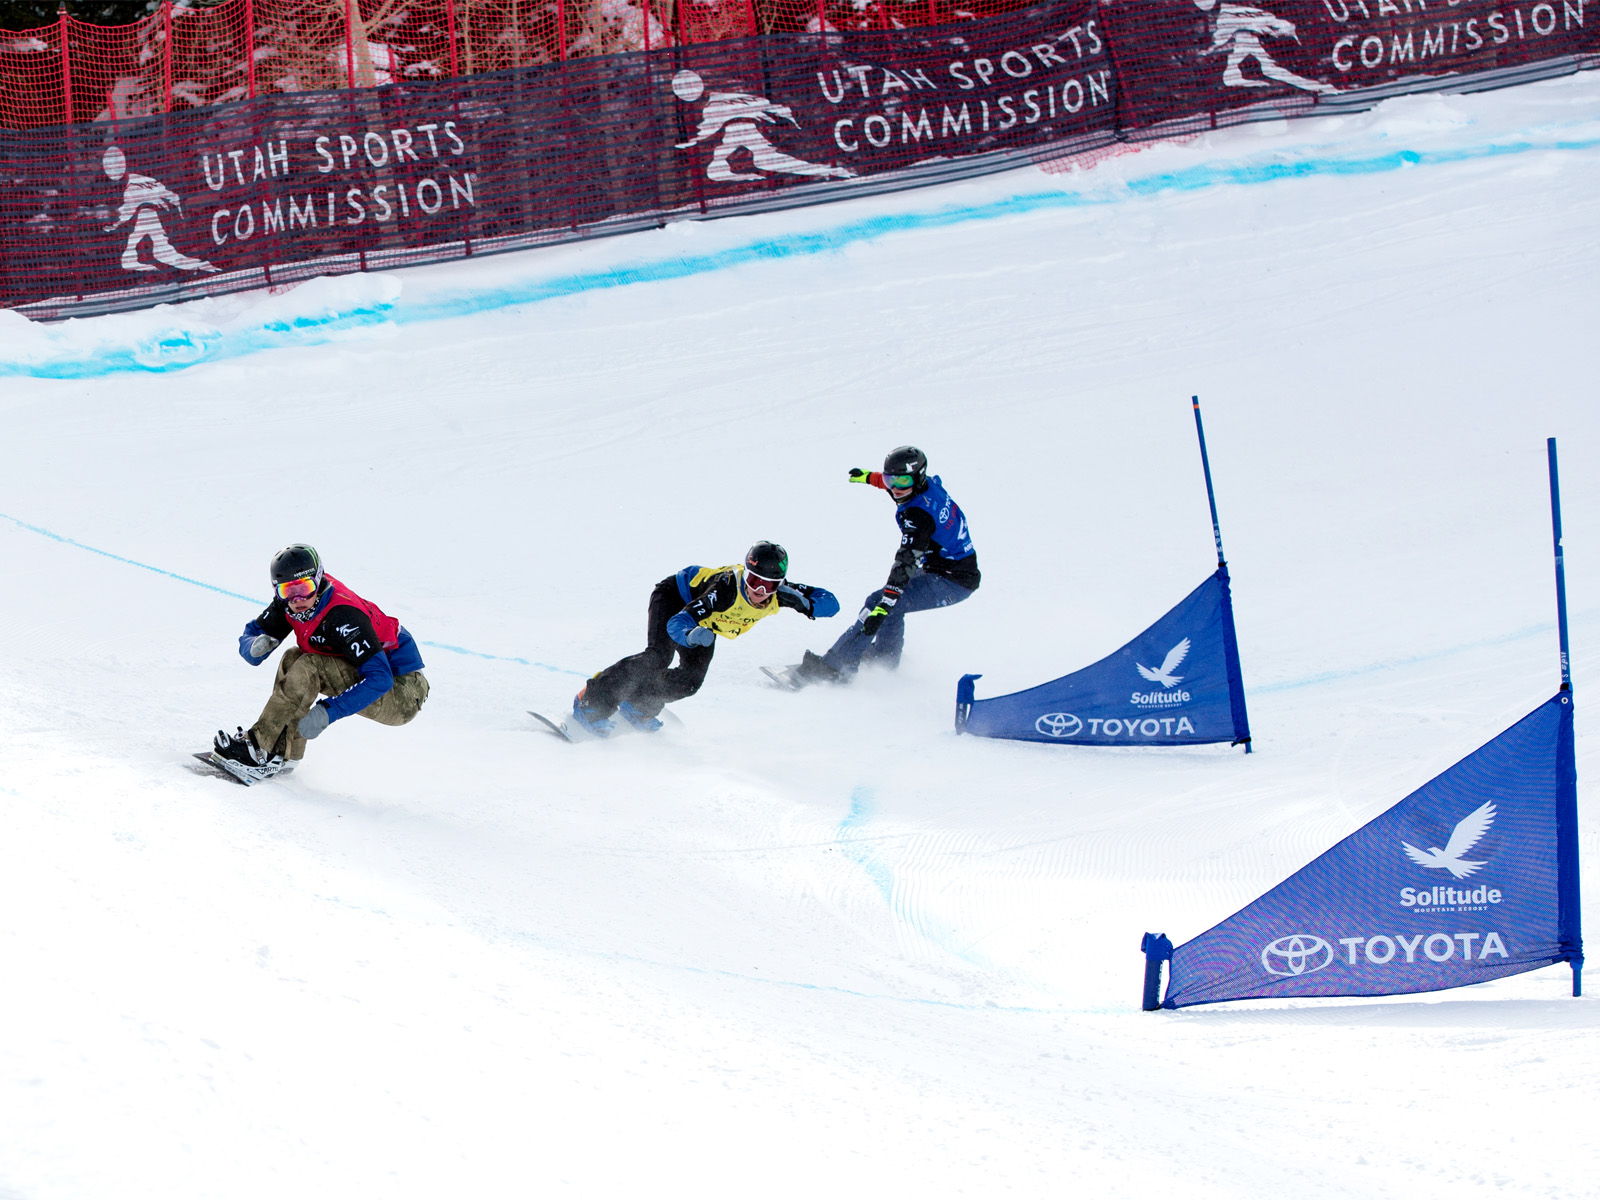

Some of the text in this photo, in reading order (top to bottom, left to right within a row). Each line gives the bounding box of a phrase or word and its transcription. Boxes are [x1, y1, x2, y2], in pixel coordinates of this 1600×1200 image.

[1331, 0, 1584, 71] COMMISSION
[816, 20, 1102, 103] UTAH SPORTS
[833, 70, 1109, 152] COMMISSION
[202, 121, 465, 191] UTAH SPORTS
[211, 172, 476, 245] COMMISSION
[692, 600, 706, 616] 72
[350, 639, 371, 658] 21
[1130, 689, 1191, 704] Solitude
[1087, 716, 1195, 737] TOYOTA
[1399, 884, 1502, 907] Solitude
[1339, 931, 1509, 965] TOYOTA
